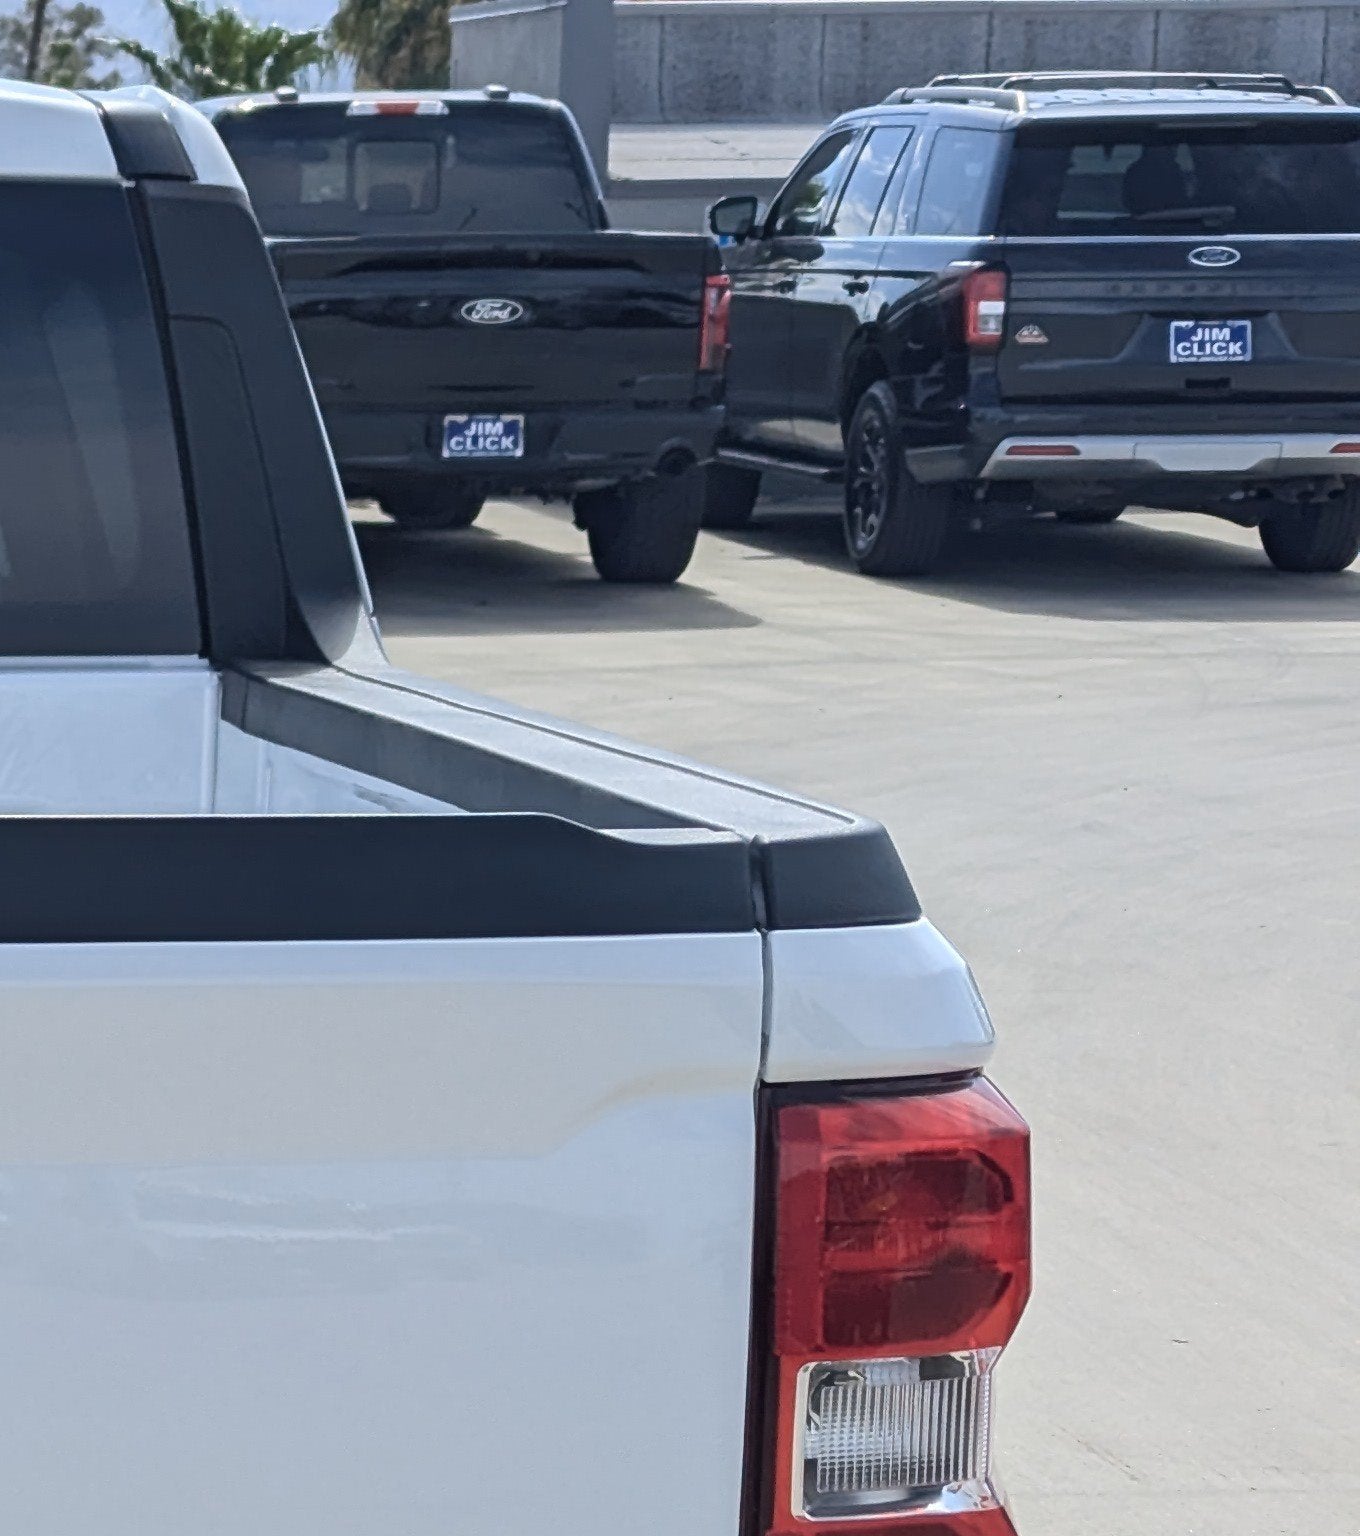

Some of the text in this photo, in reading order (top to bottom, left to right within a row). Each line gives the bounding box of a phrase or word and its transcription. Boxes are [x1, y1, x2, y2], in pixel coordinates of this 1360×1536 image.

[471, 299, 512, 320] Ford
[1191, 327, 1231, 341] JIM
[1176, 341, 1243, 356] CLICK
[464, 421, 504, 436] JIM
[449, 435, 515, 451] CLICK
